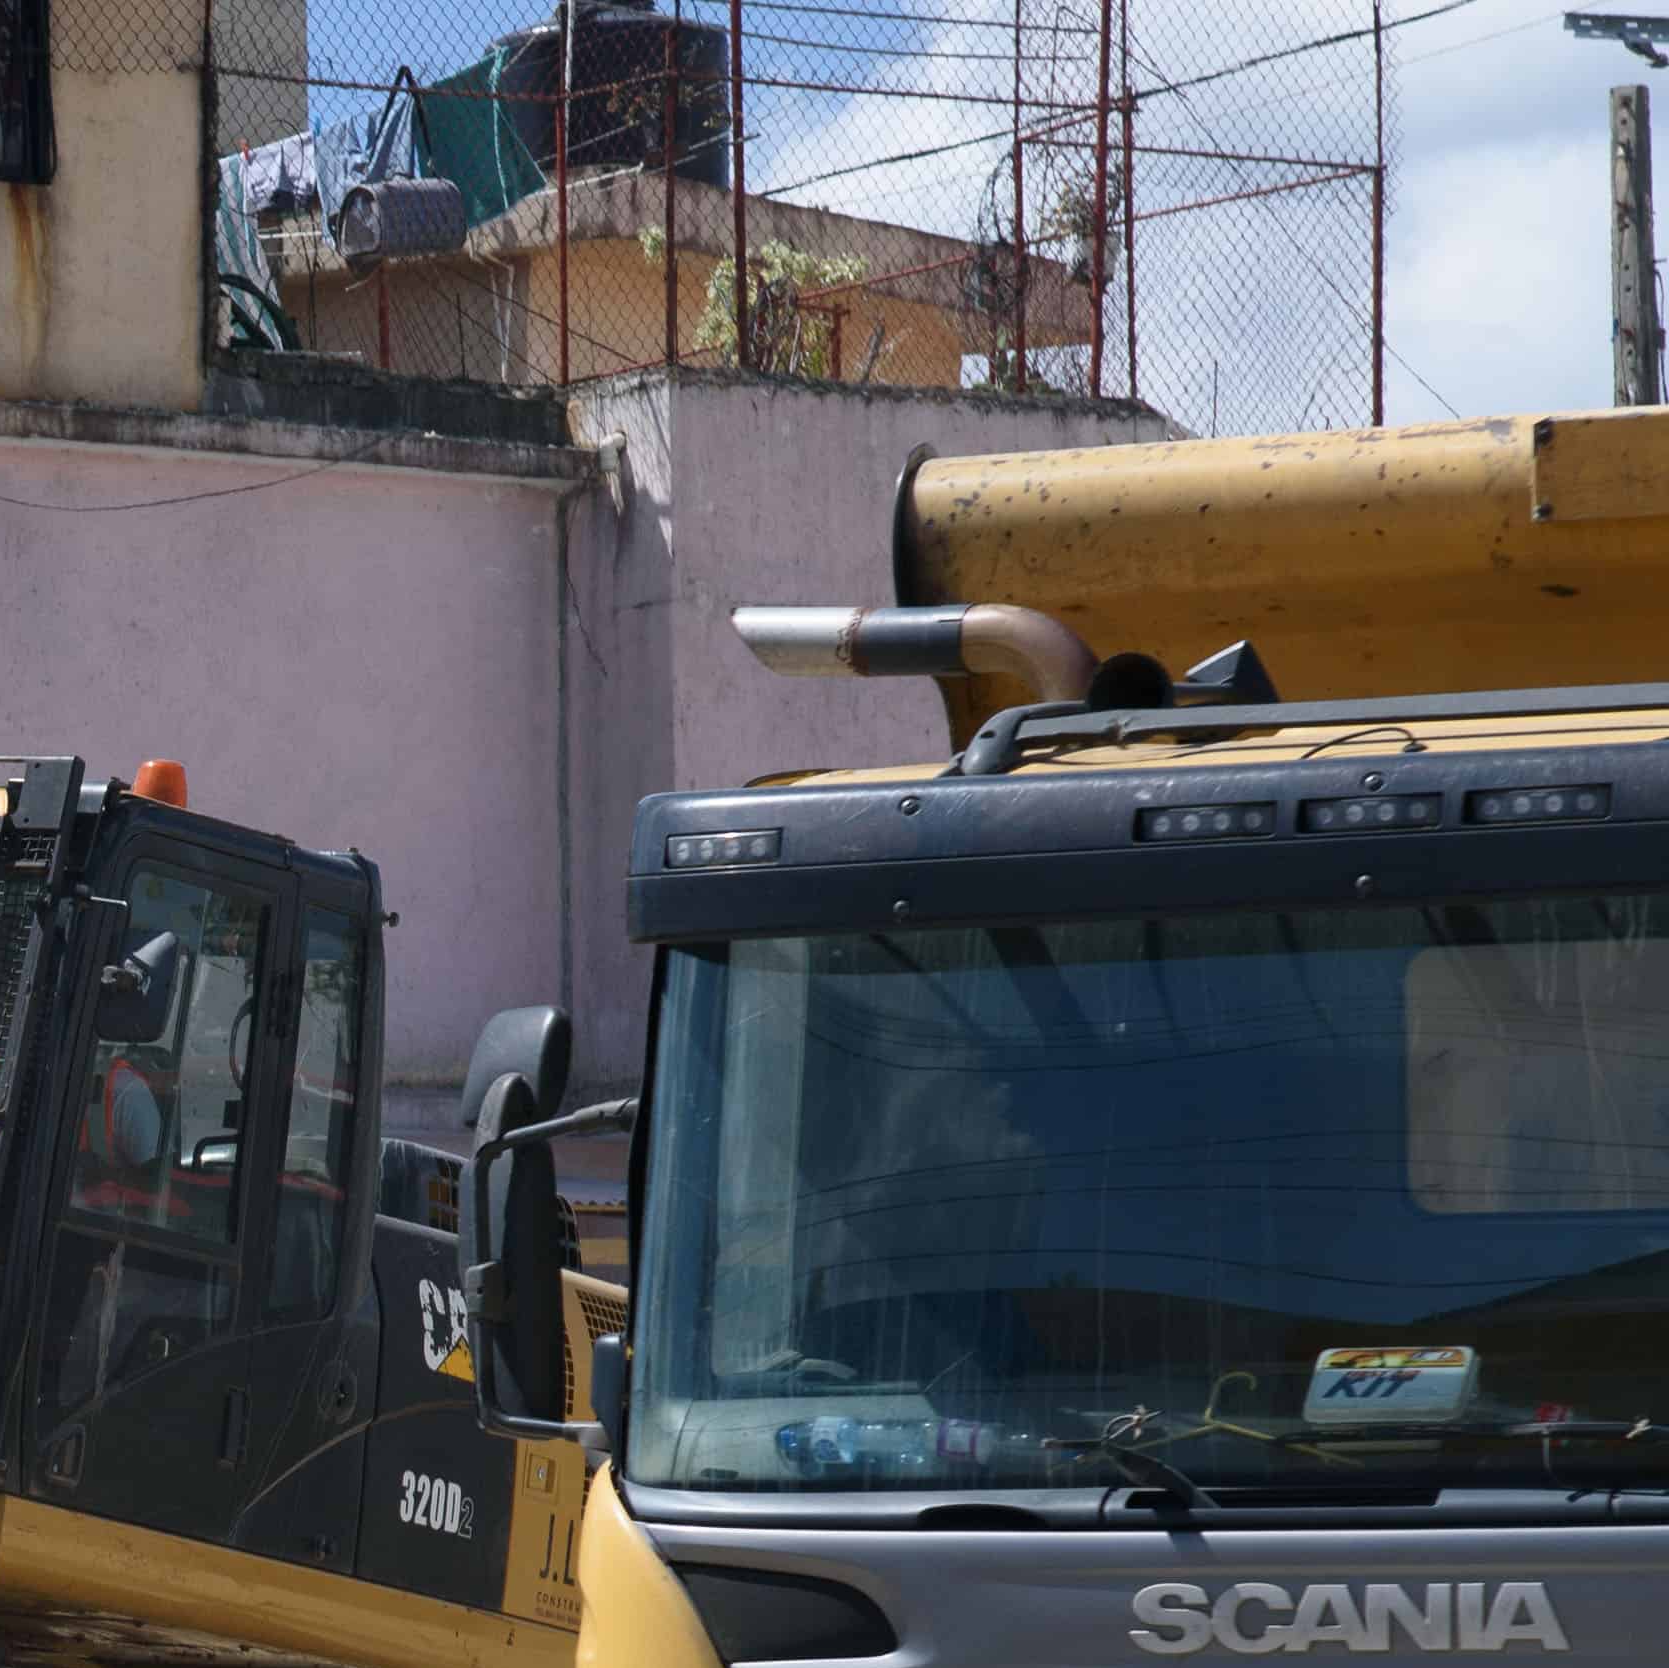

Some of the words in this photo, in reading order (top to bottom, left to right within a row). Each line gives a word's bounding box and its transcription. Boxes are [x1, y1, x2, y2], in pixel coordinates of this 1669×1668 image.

[1322, 1371, 1418, 1398] KIT
[536, 1591, 581, 1613] CONSTRU
[1129, 1582, 1570, 1654] SCANIA
